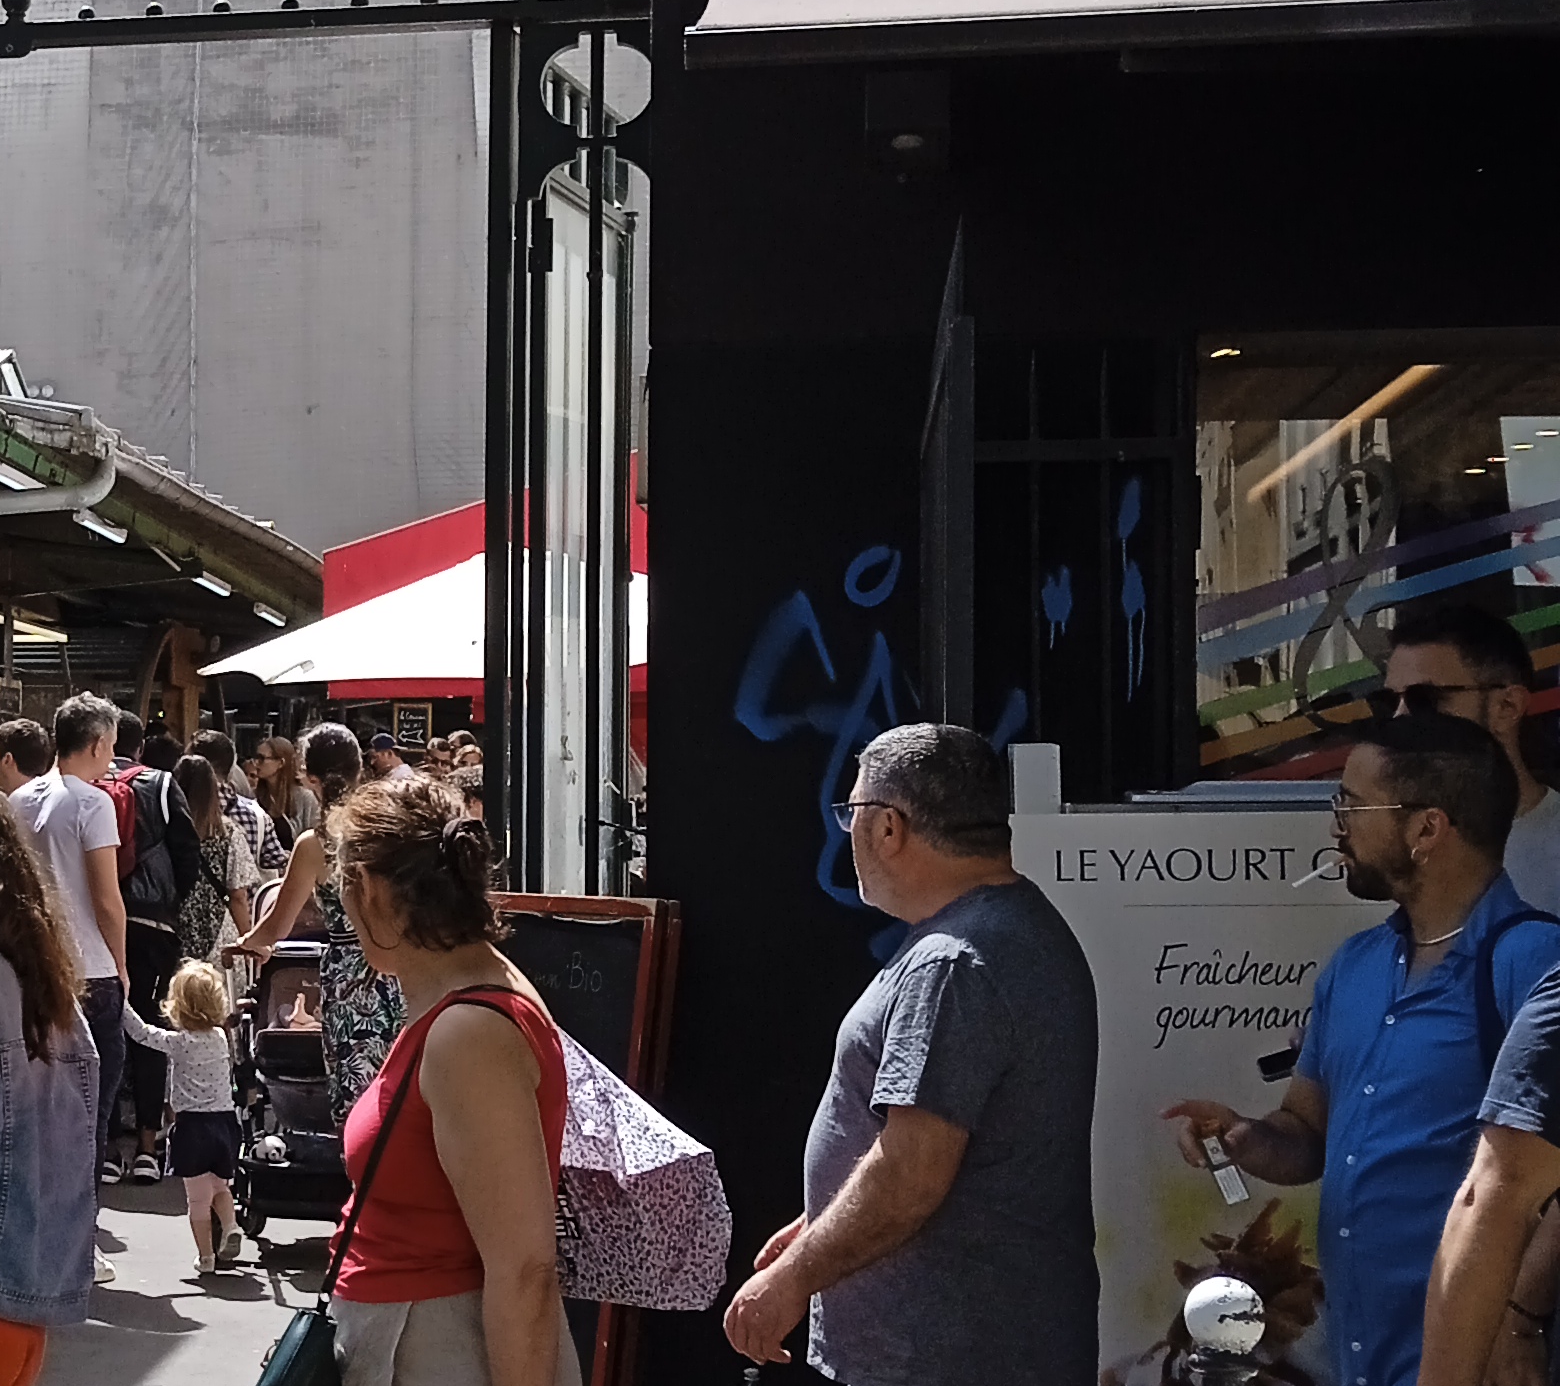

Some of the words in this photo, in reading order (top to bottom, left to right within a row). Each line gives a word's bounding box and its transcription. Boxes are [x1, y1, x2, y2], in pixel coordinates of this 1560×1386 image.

[1055, 849, 1098, 882] LE
[1108, 847, 1296, 883] YAOURT
[1311, 846, 1345, 881] G
[568, 951, 602, 993] Bio
[1153, 942, 1317, 986] Fraîcheur
